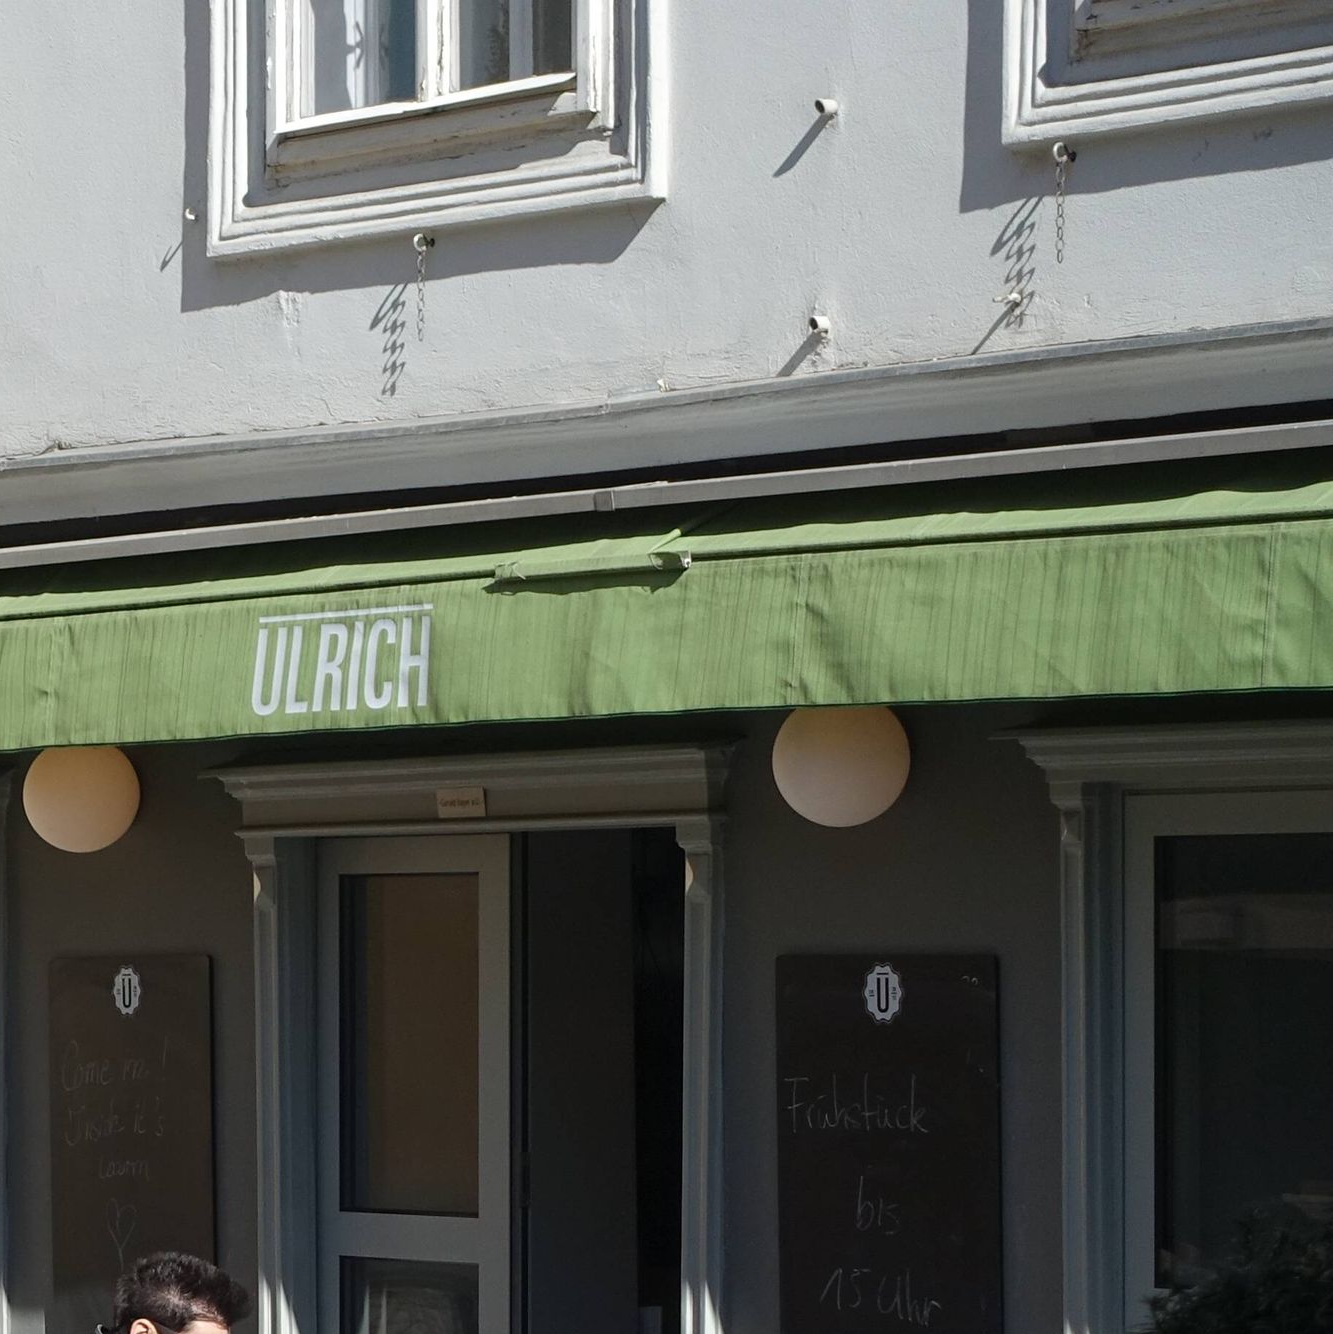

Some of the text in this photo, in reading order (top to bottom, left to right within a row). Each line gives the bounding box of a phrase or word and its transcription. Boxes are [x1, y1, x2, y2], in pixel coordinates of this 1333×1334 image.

[251, 614, 431, 716] ULRICH
[60, 1038, 113, 1092] Come
[783, 1072, 930, 1134] Frühstück
[855, 1175, 901, 1236] bis
[819, 1267, 943, 1328] 15 Uhr
